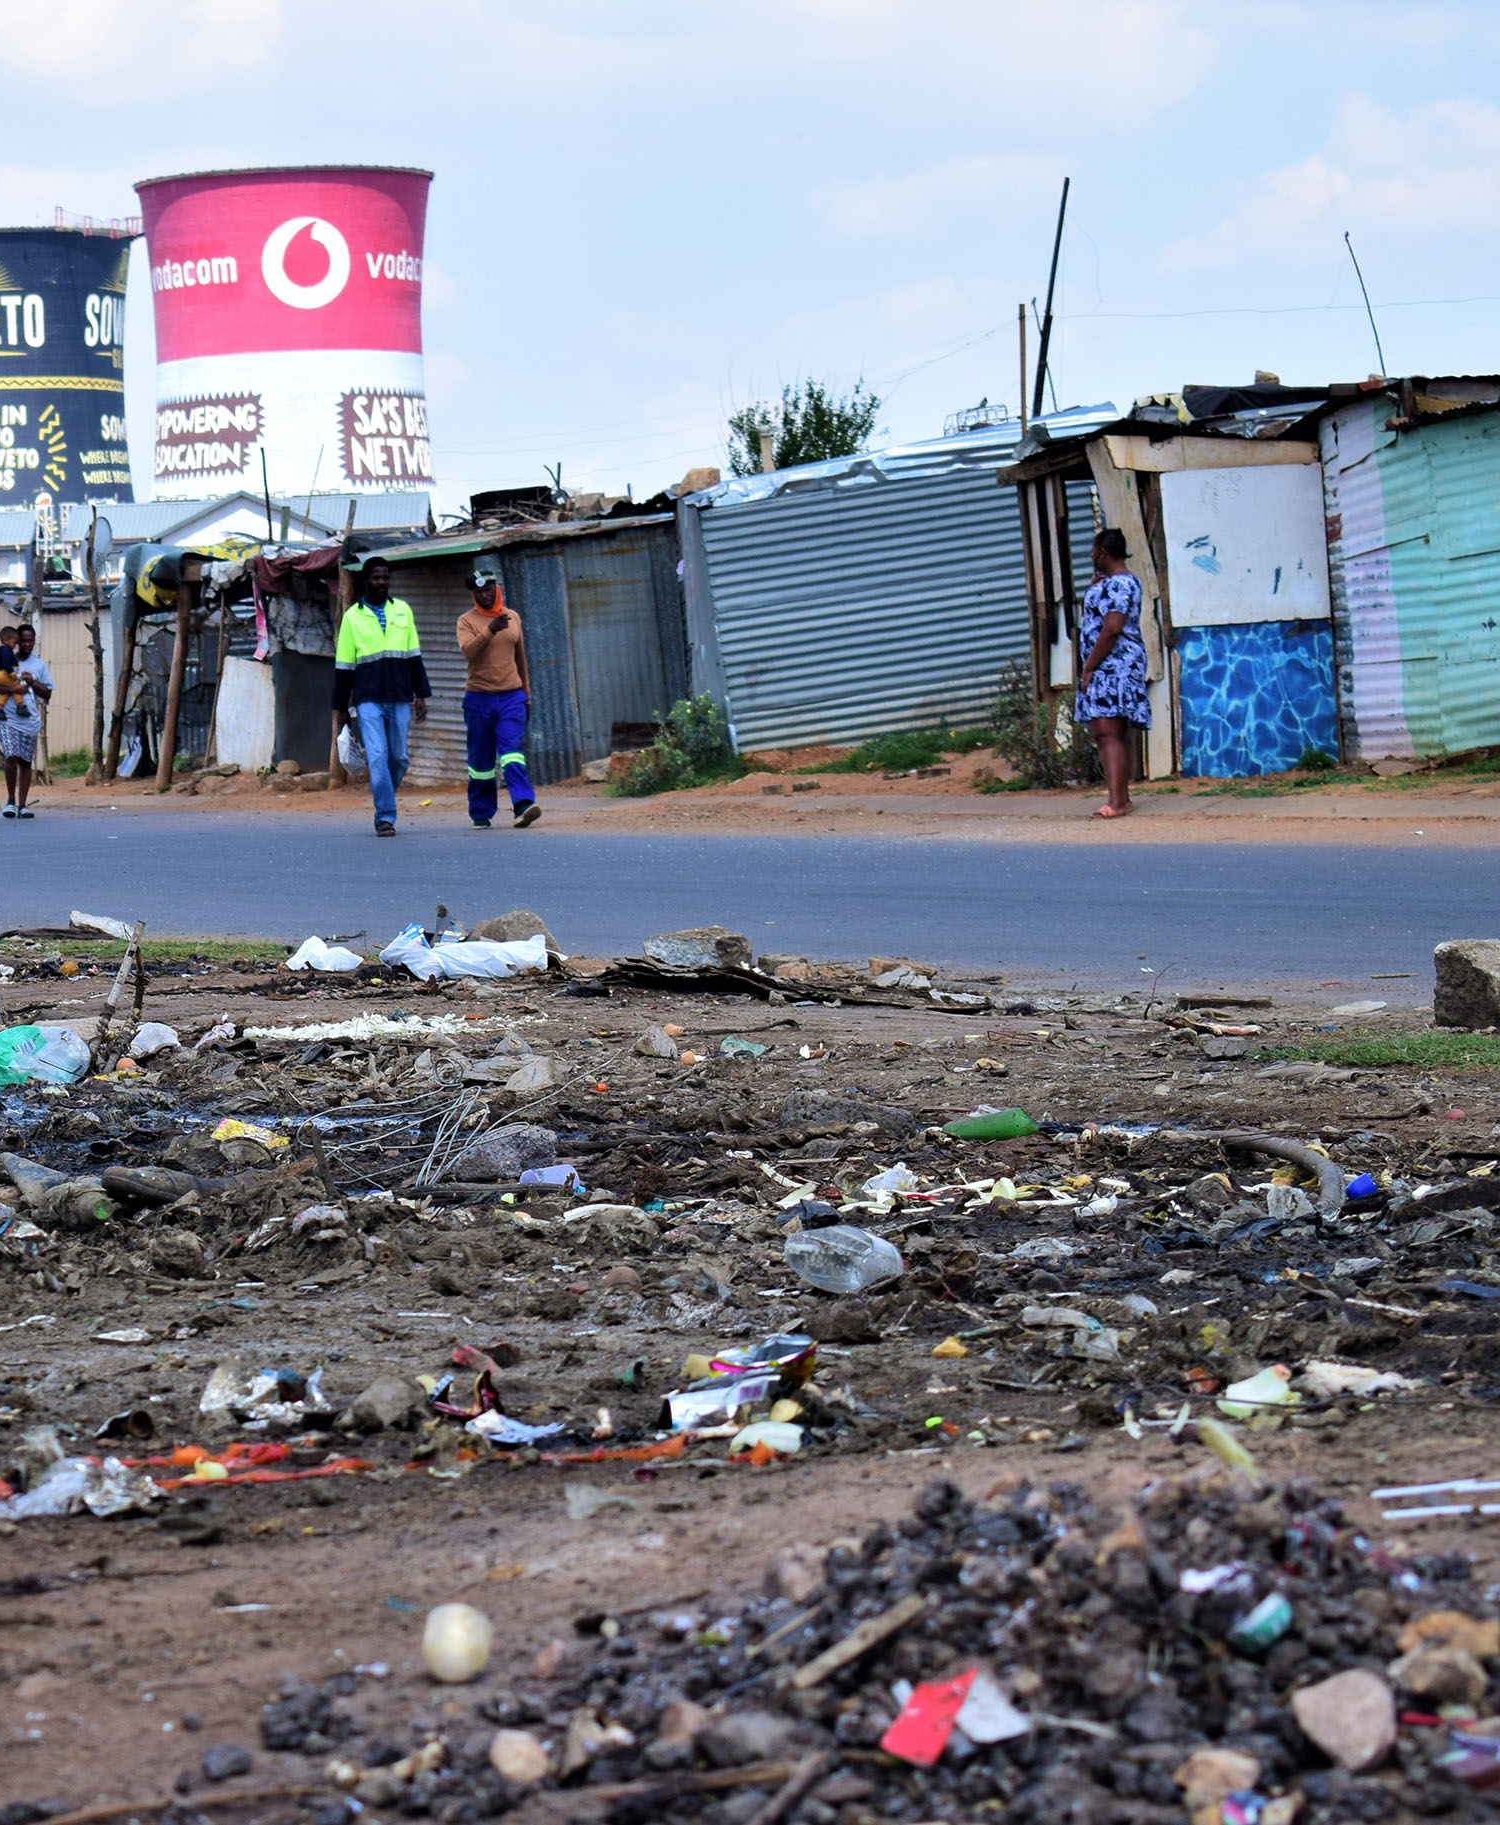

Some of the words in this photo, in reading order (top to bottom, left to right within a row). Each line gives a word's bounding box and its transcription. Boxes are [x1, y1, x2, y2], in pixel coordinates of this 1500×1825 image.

[1, 404, 27, 426] IN
[156, 402, 258, 441] MPOWERING
[352, 395, 402, 436] SA'S
